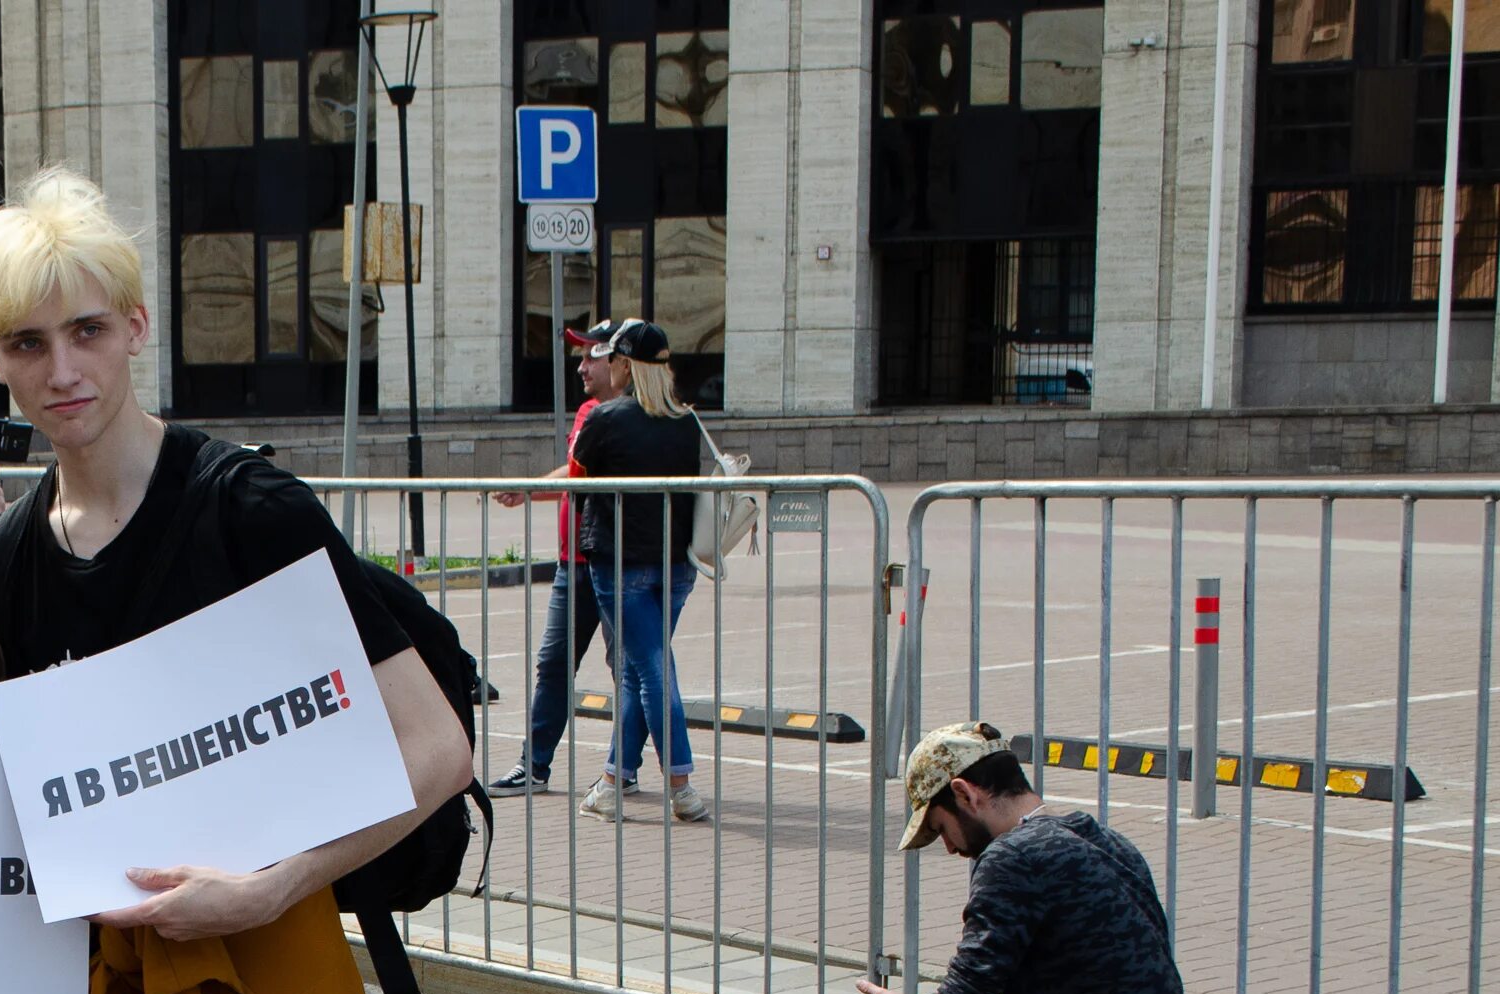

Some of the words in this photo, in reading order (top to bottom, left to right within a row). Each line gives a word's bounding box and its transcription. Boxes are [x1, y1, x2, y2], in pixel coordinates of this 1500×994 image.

[540, 118, 582, 190] P
[536, 221, 546, 232] 10
[552, 220, 563, 234] 15
[570, 219, 584, 235] 20
[42, 776, 73, 818] Я
[75, 767, 105, 808] В
[108, 668, 352, 798] БЕШЕНСТВЕ!
